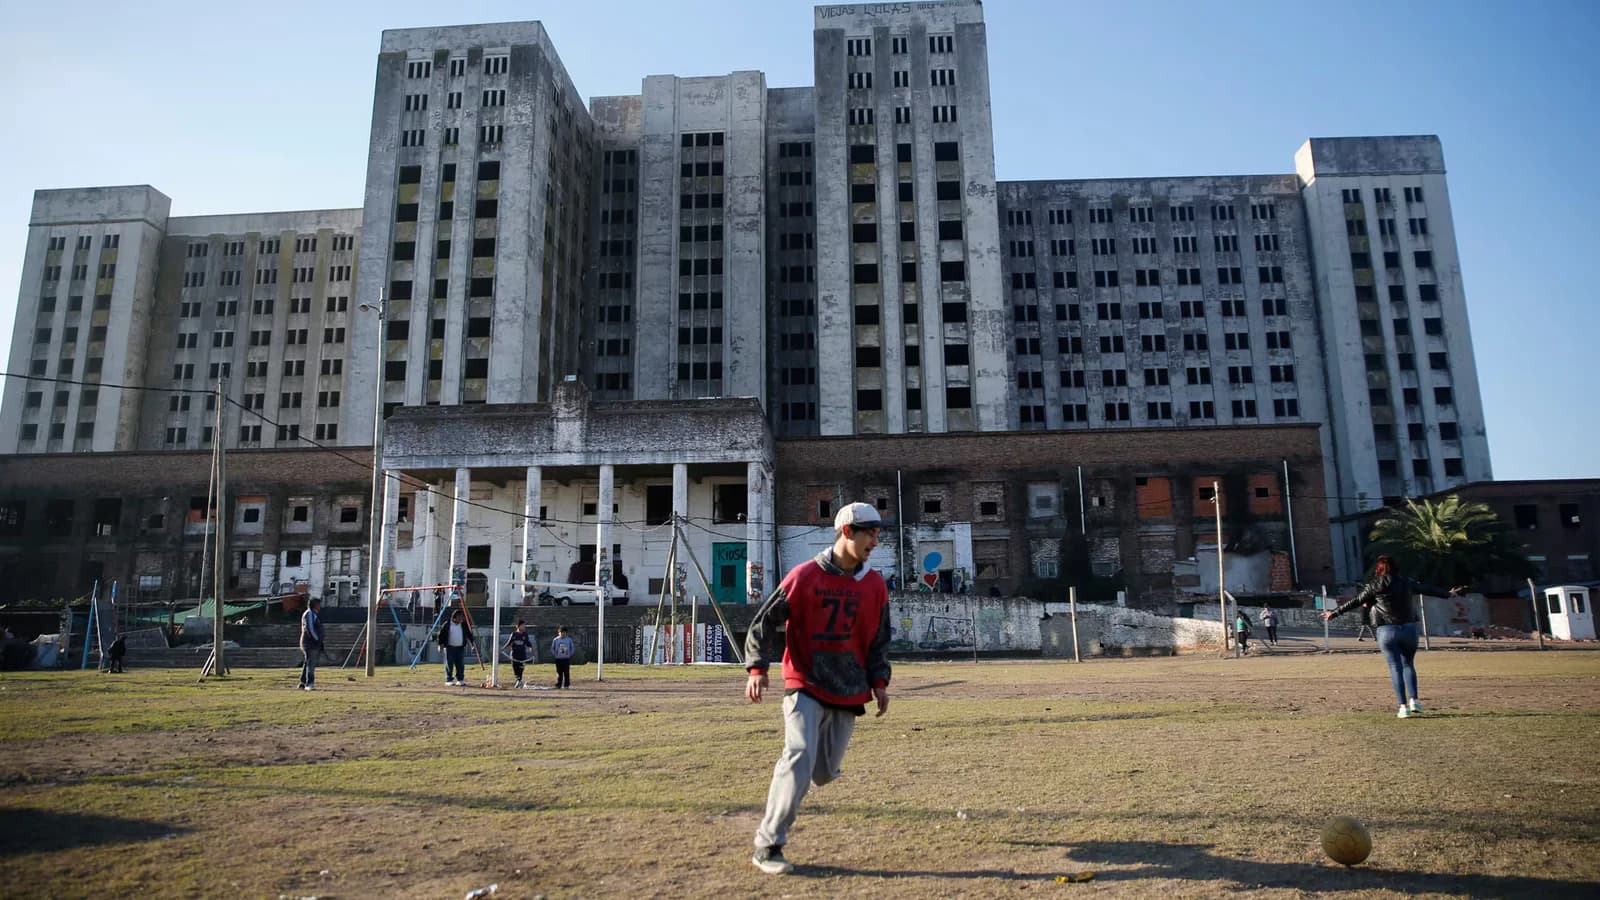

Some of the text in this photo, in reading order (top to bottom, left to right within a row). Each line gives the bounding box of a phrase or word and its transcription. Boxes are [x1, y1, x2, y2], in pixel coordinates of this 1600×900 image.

[820, 7, 855, 19] VIEJAS
[822, 598, 860, 633] 75
[714, 624, 723, 654] GONZALEZ
